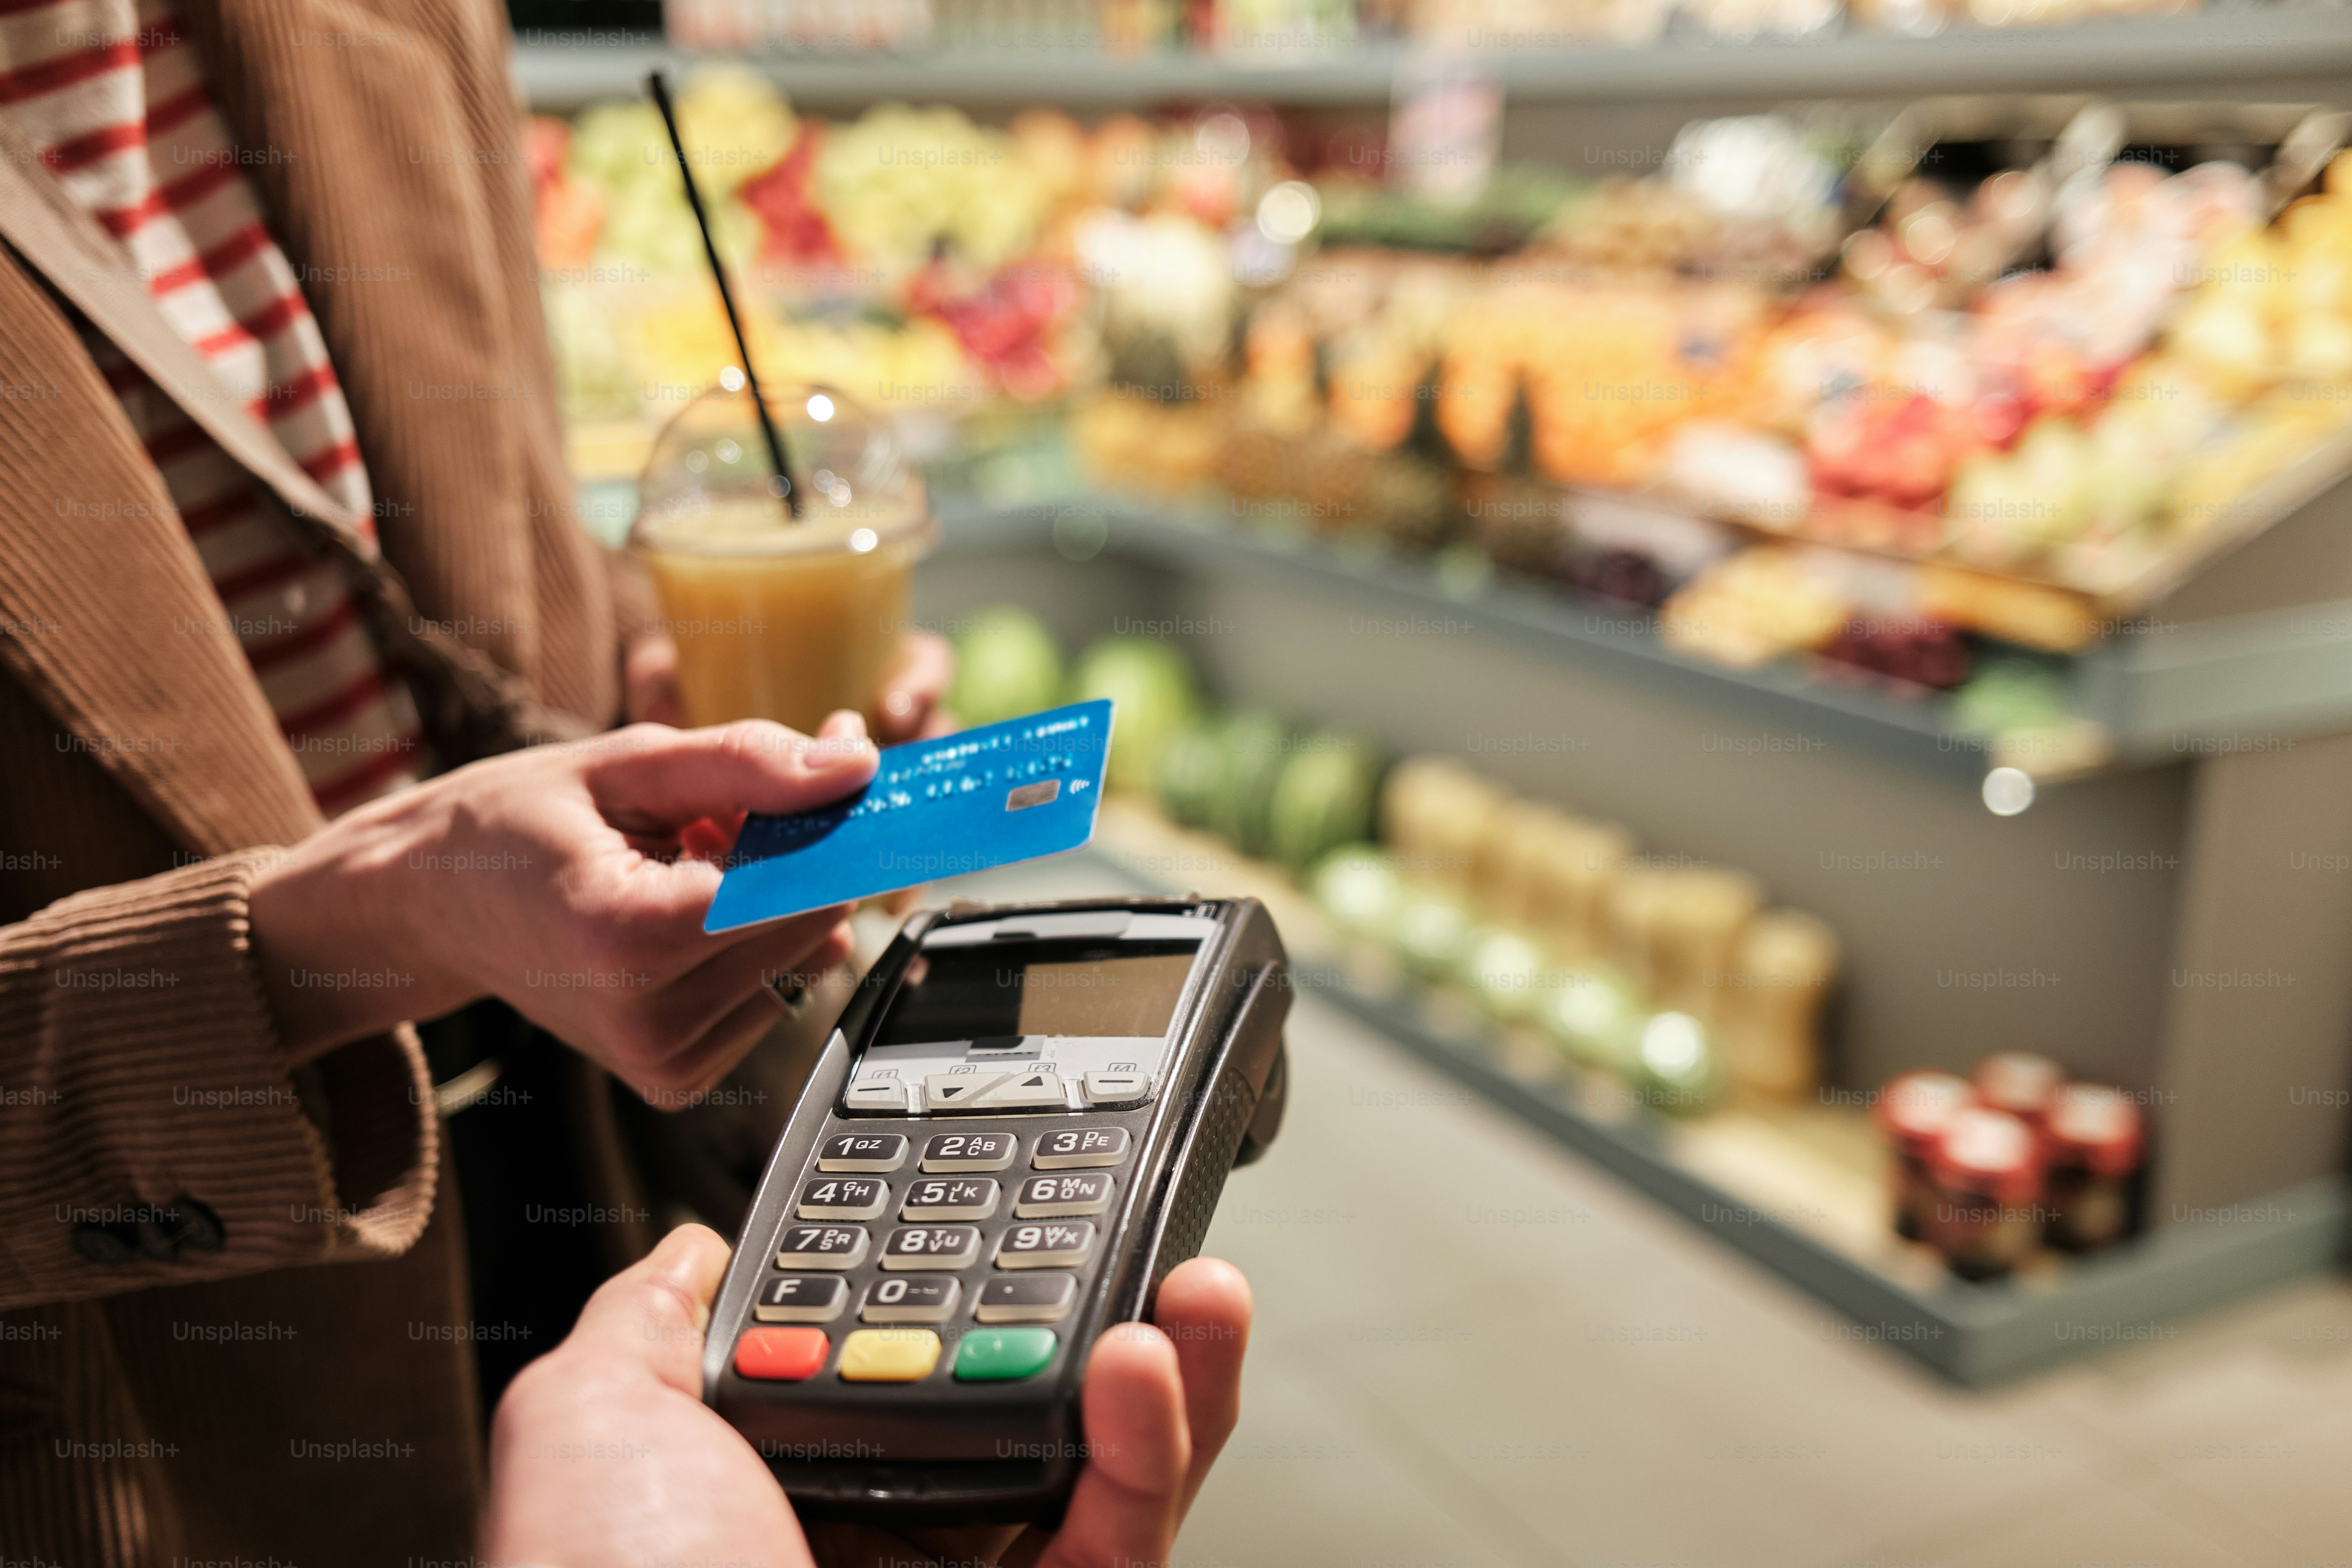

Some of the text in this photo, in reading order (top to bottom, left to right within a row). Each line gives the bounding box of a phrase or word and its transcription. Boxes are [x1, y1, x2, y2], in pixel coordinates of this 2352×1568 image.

[838, 1137, 882, 1155] 1 QZ
[939, 1137, 965, 1155] 2
[1053, 1133, 1078, 1151] 3
[812, 1183, 838, 1202] 4
[921, 1183, 947, 1203] 5
[1031, 1179, 1058, 1200] 6
[795, 1229, 821, 1250] 7
[900, 1230, 928, 1252] 8
[1014, 1227, 1042, 1249] 9
[773, 1279, 801, 1303] F
